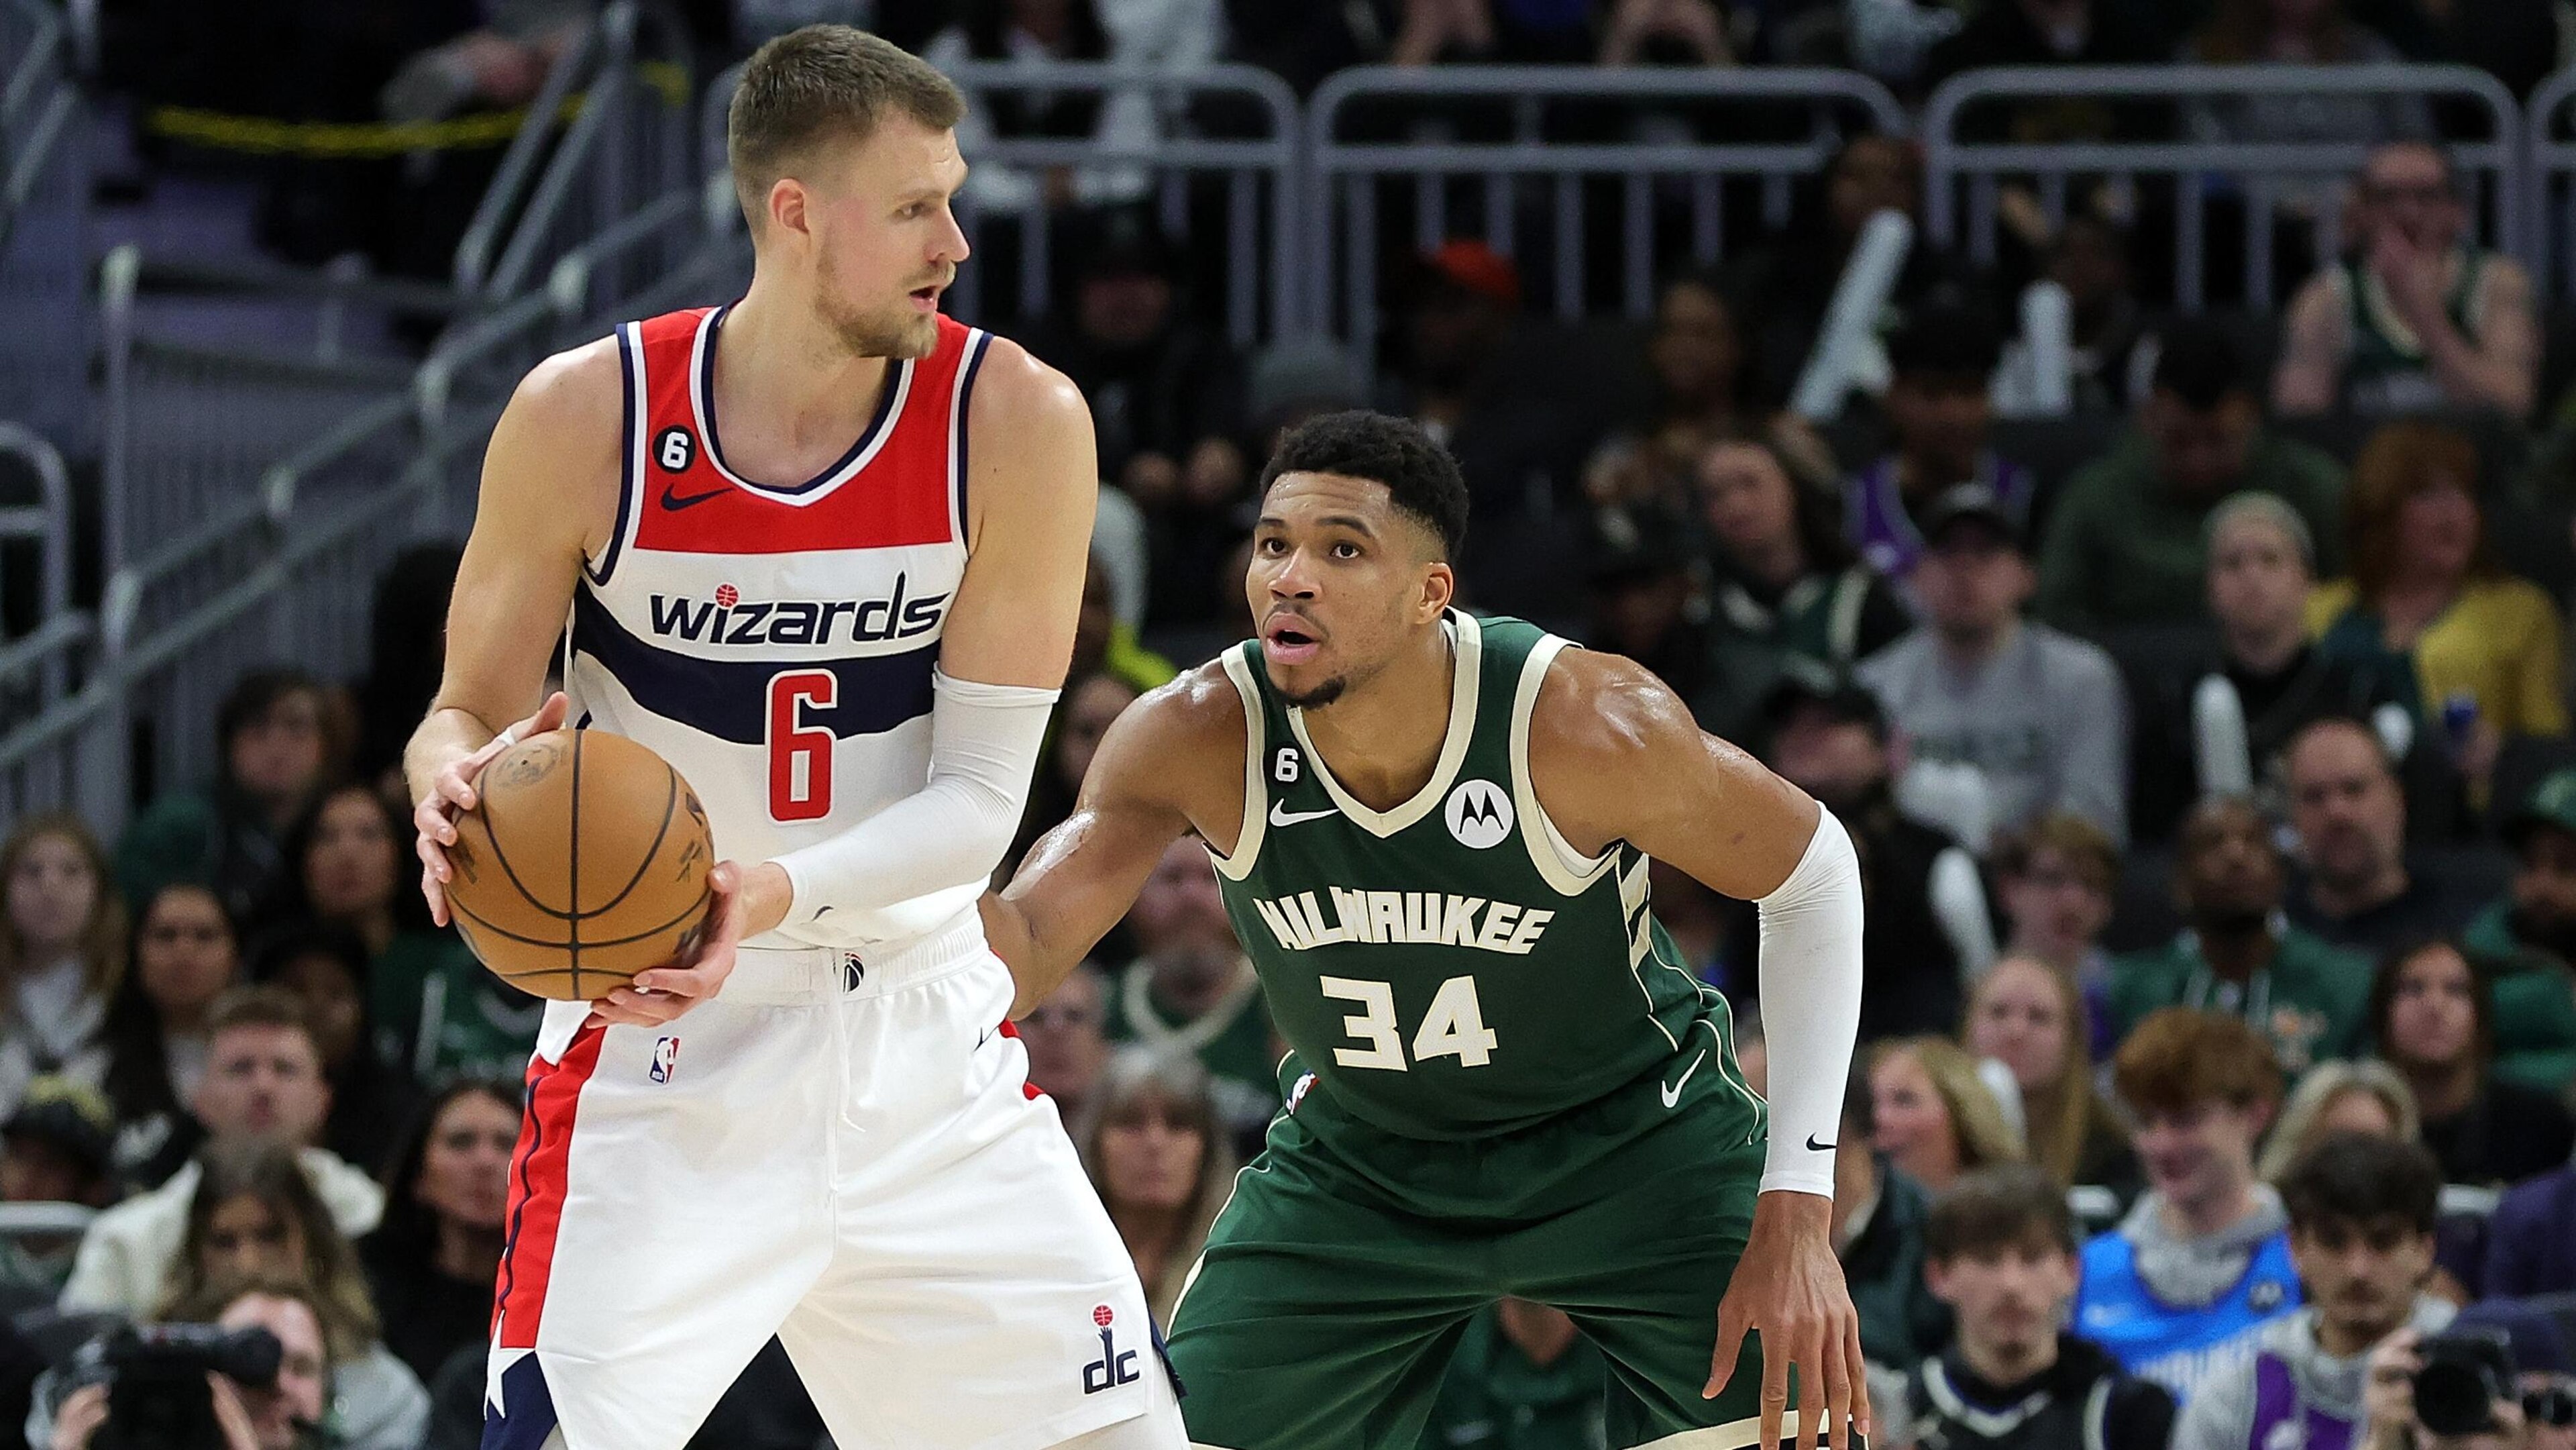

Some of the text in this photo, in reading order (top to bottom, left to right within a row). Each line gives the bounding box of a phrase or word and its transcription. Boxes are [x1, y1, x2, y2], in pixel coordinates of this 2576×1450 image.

[662, 431, 688, 468] 6
[650, 571, 951, 644] wizards
[767, 668, 837, 824] 6
[1275, 748, 1298, 782] 6
[1253, 886, 1555, 954] MILWAUKEE
[1320, 975, 1498, 1072] 34
[1083, 1327, 1140, 1394] dc
